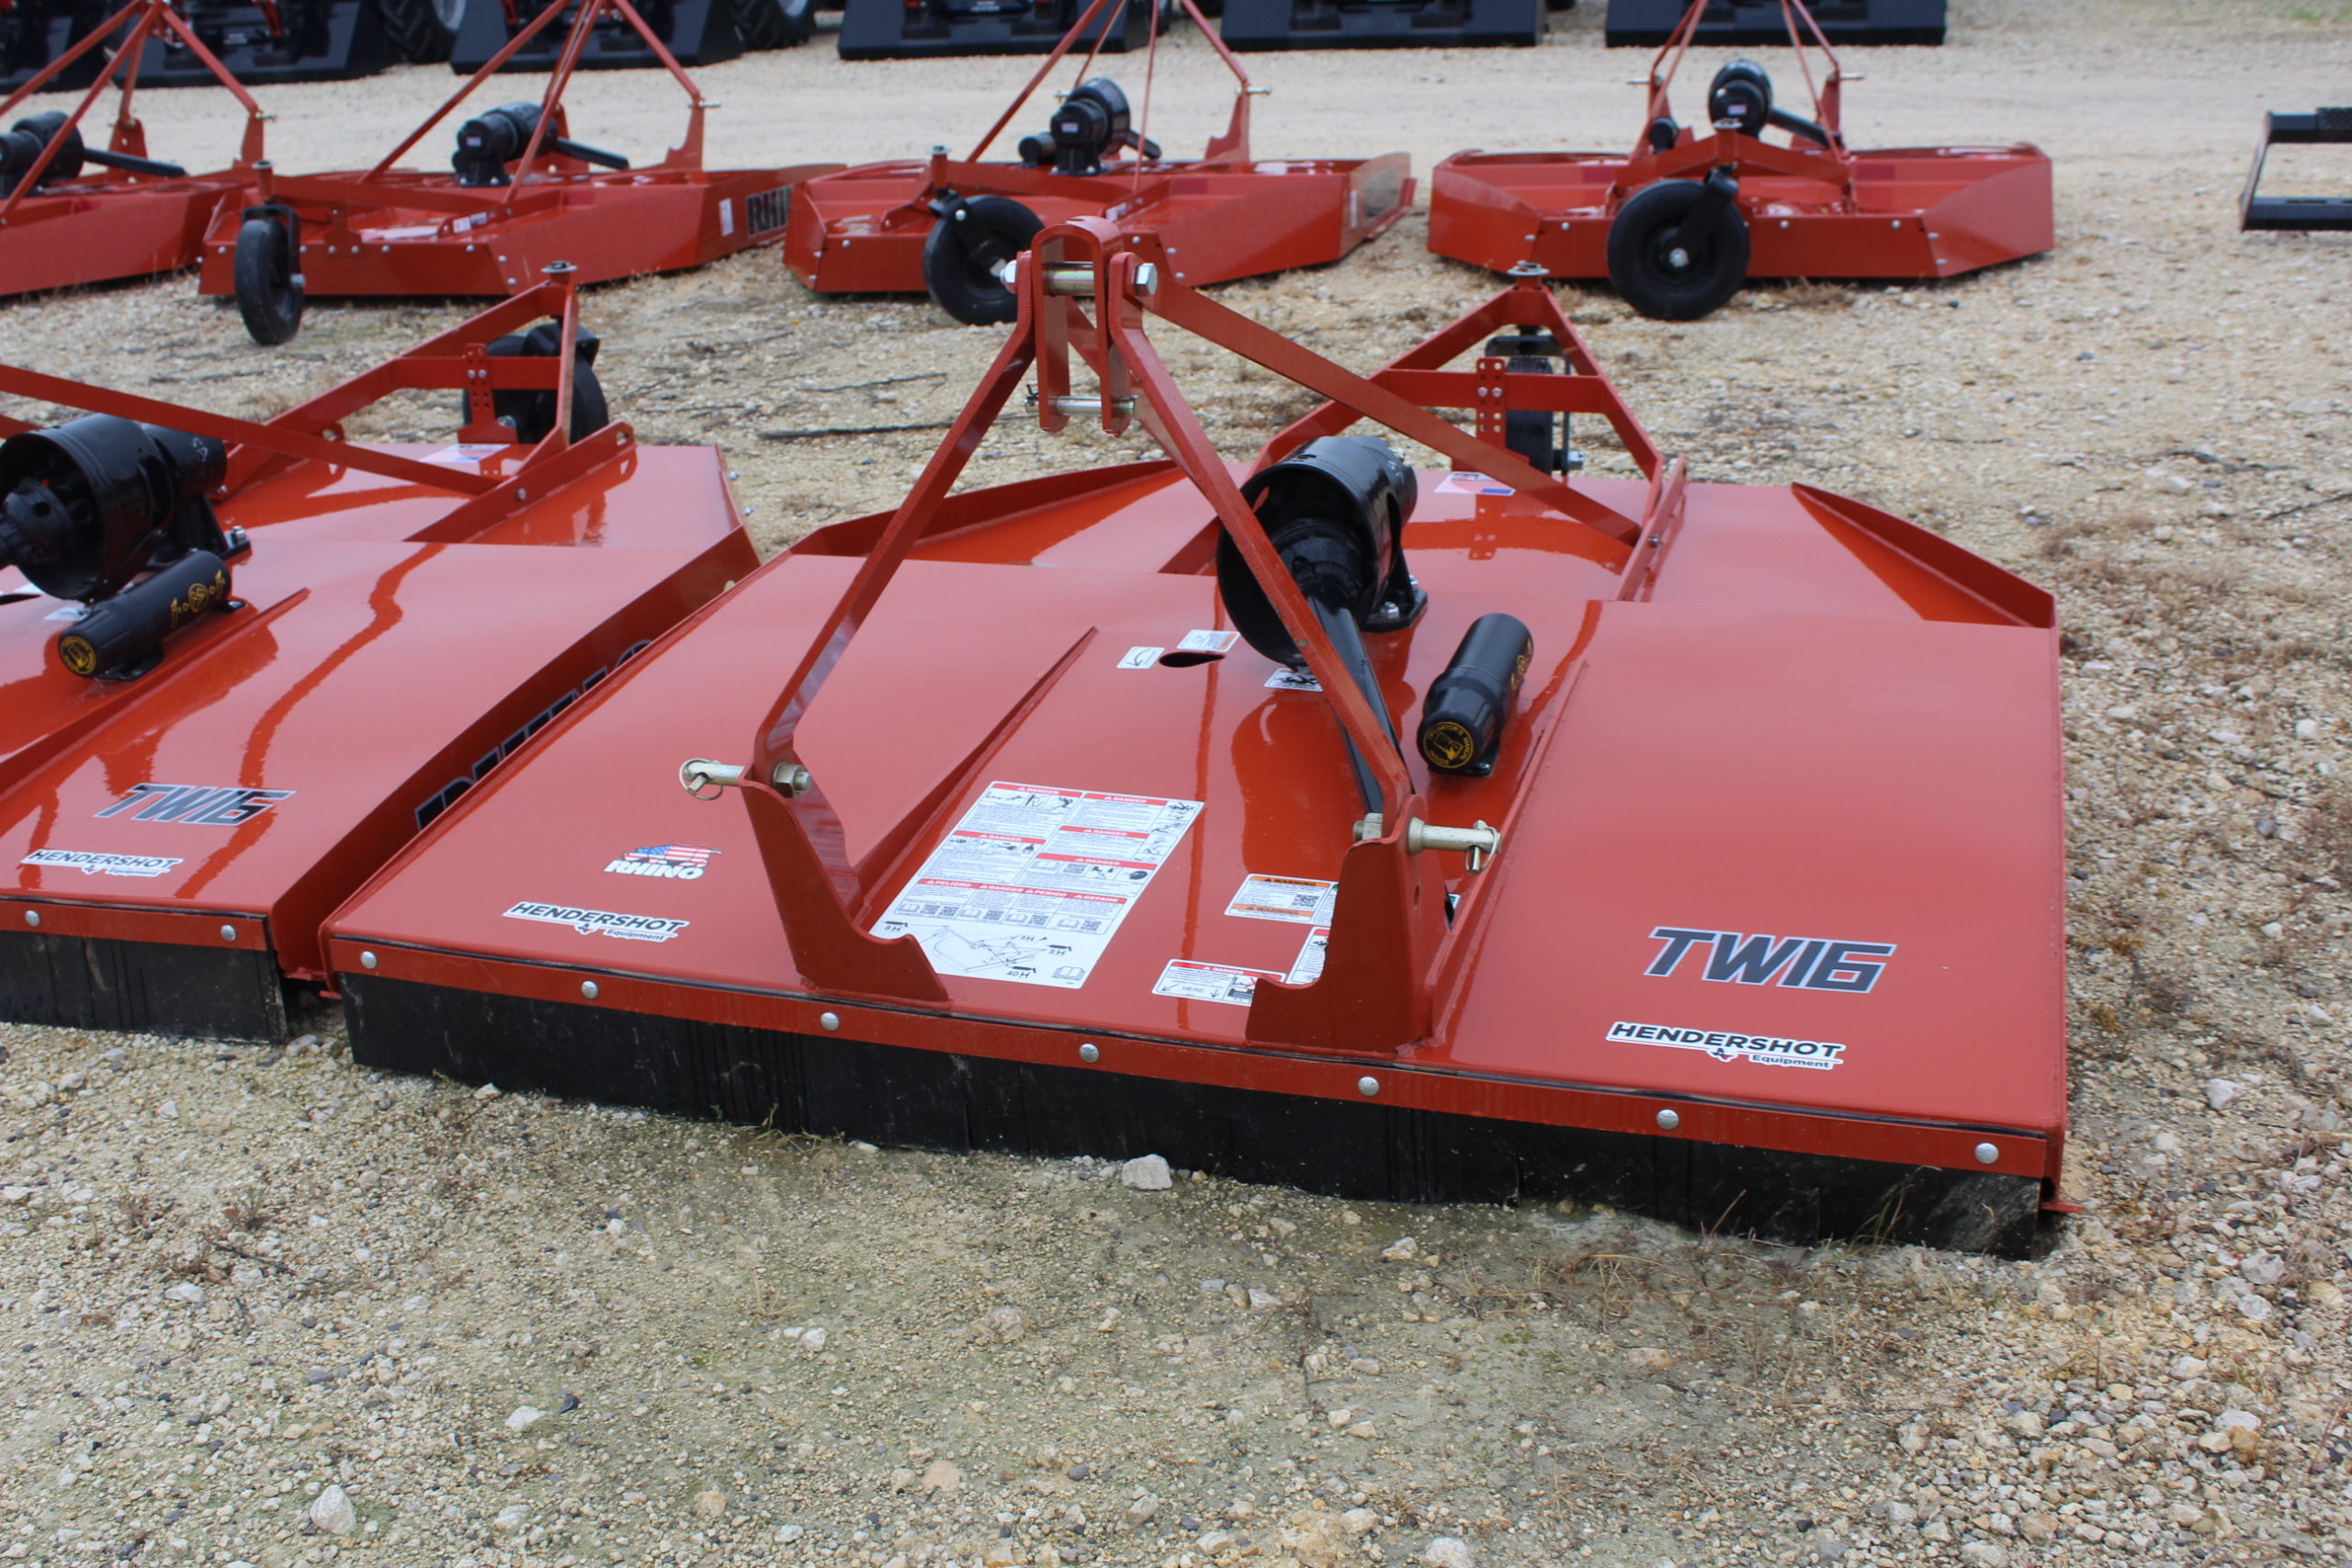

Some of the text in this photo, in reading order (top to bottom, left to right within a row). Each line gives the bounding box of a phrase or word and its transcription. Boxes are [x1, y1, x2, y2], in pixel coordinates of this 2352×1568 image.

[28, 851, 178, 869] HENDERSHOT
[603, 859, 705, 880] RHINO
[1273, 878, 1317, 887] WARNING
[511, 902, 685, 933] HENDERSHOT
[1257, 906, 1300, 916] WARNING
[605, 928, 665, 942] Equipment
[1212, 966, 1245, 975] DANGER
[1611, 1021, 1842, 1058] HENDERSHOT
[1751, 1054, 1831, 1070] Equipment
